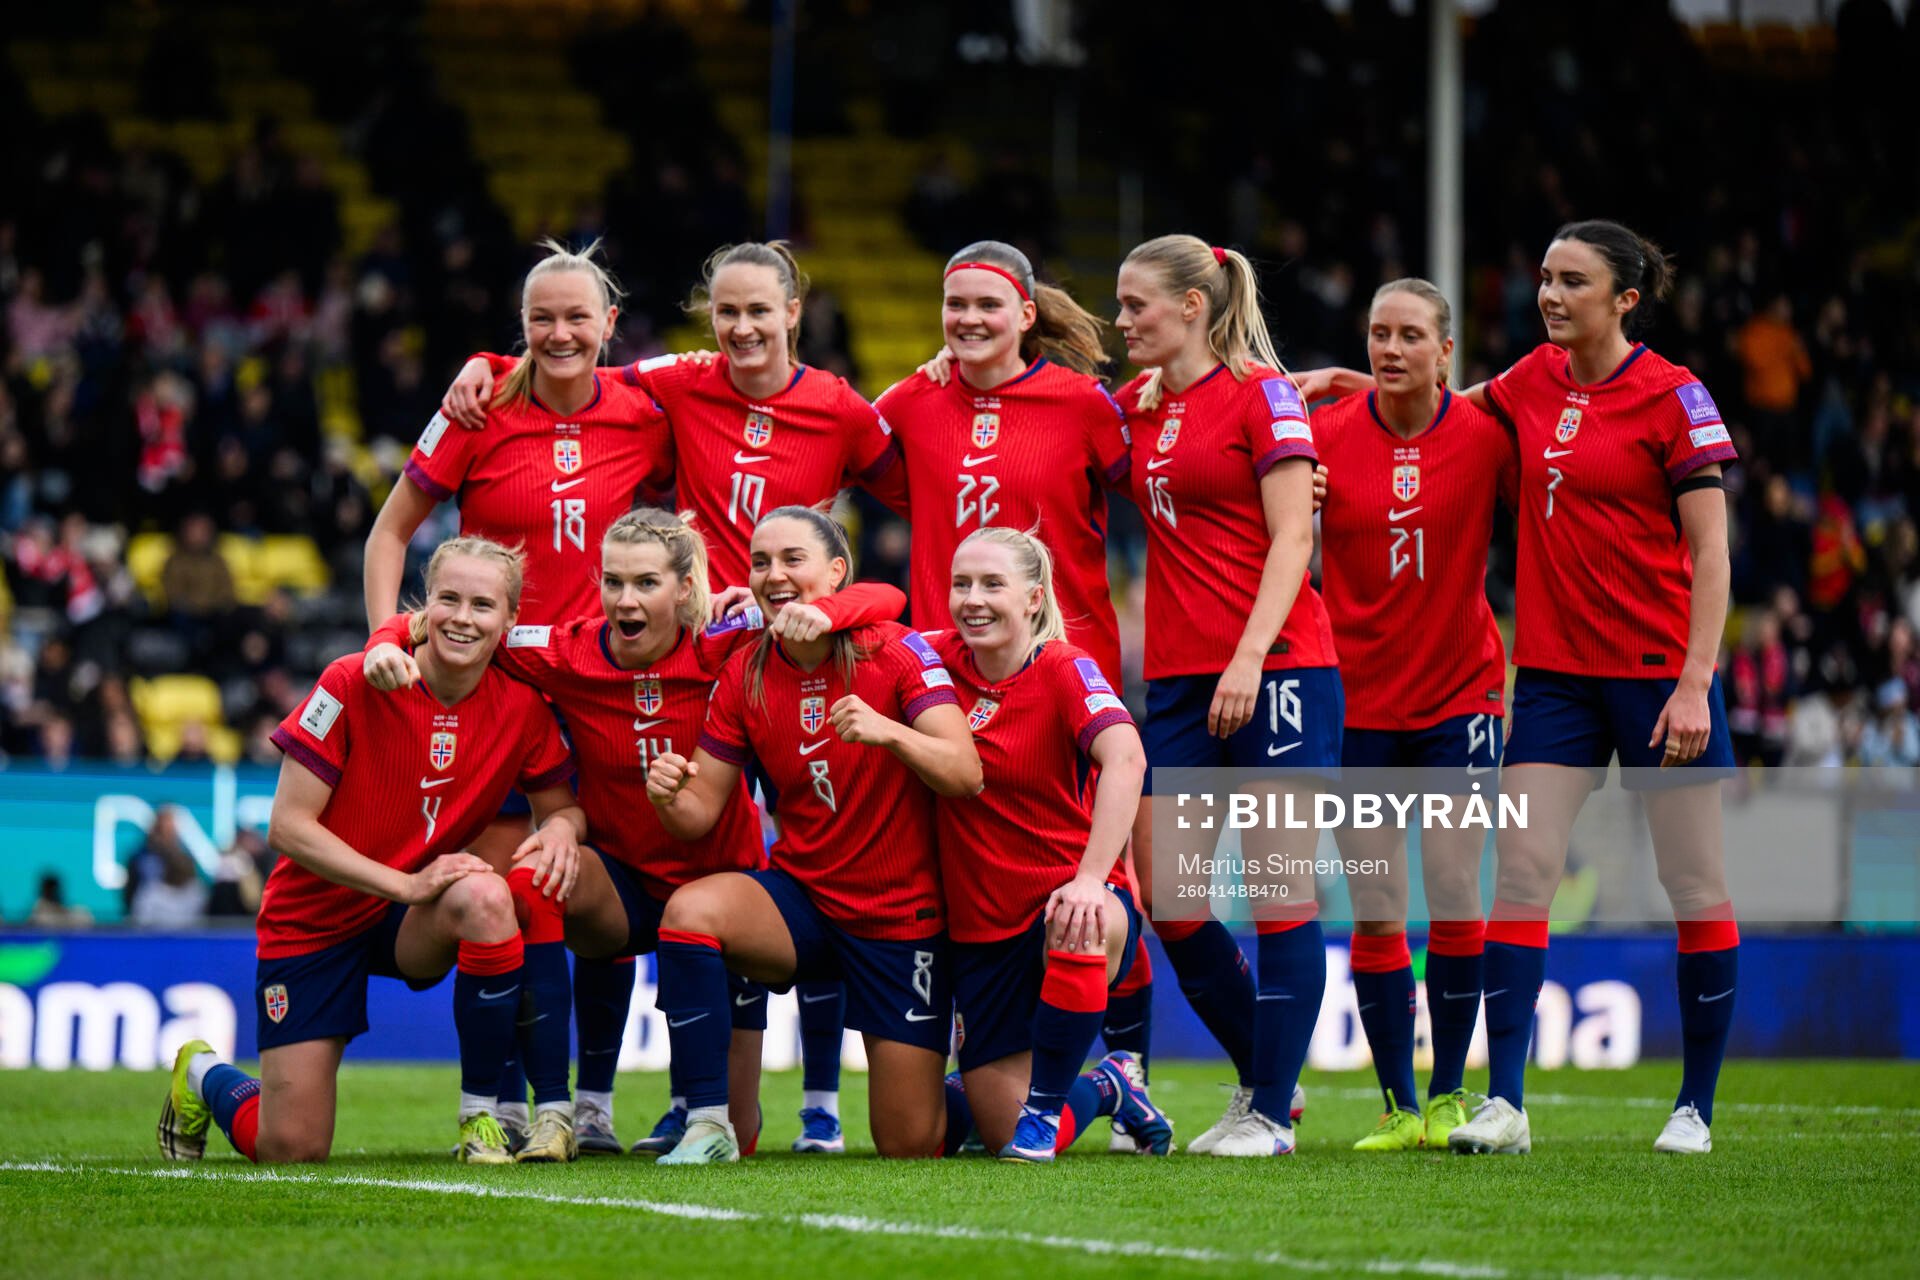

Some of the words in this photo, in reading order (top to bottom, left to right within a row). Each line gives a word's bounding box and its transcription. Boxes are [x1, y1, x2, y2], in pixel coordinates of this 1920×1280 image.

[729, 471, 766, 527] 10
[956, 473, 1000, 528] 22
[1145, 476, 1178, 529] 16
[1545, 467, 1564, 520] 7
[551, 498, 586, 553] 18
[1389, 527, 1425, 582] 21
[1266, 679, 1303, 734] 16
[808, 760, 837, 813] 8
[421, 796, 442, 844] 4
[912, 950, 934, 1006] 8
